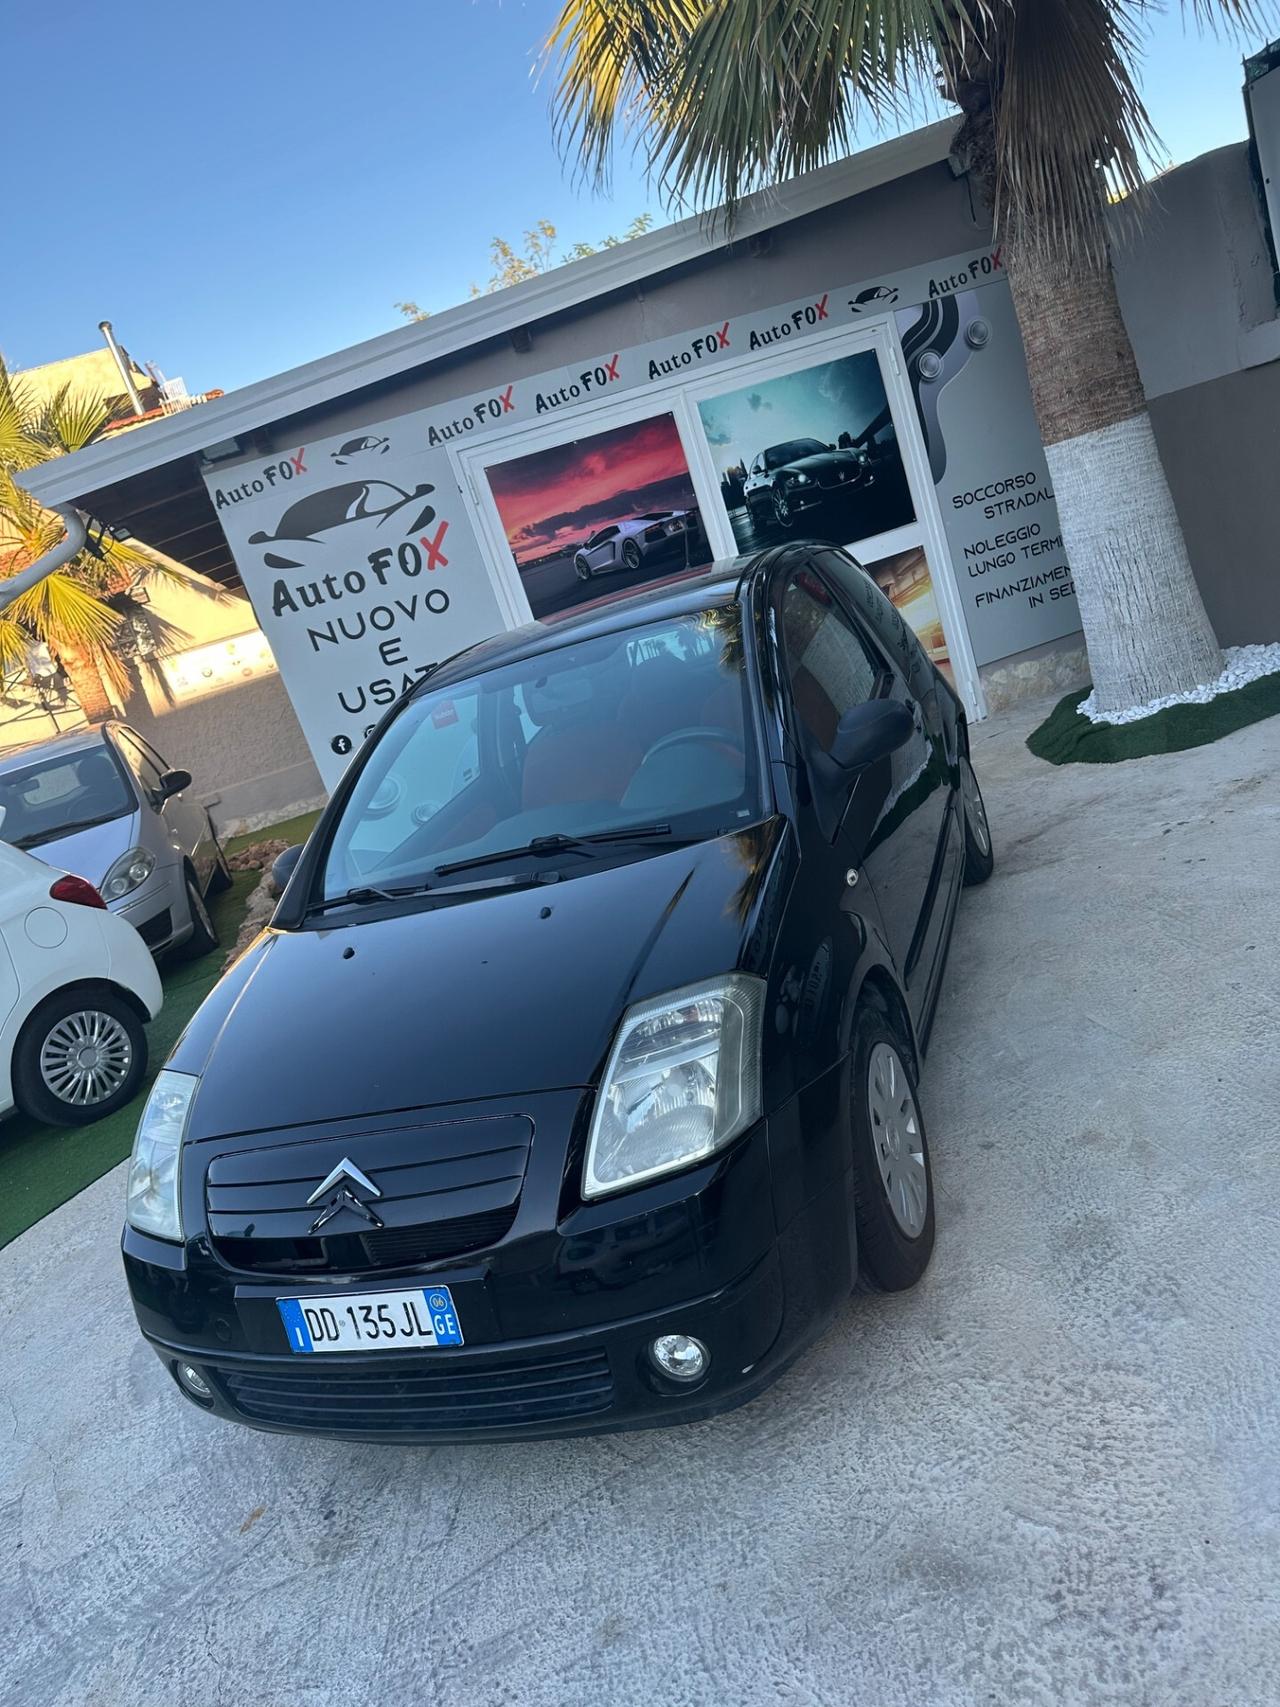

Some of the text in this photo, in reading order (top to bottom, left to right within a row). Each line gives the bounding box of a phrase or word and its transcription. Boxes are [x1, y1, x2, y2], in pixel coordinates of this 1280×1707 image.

[928, 244, 1003, 298] Auto FOX
[750, 293, 828, 350] Auto FOX
[649, 322, 730, 380] Auto FOX
[536, 354, 620, 414] Auto FOX
[428, 385, 515, 446] Auto FOX
[215, 448, 308, 510] Auto FOX
[952, 471, 1036, 509] SOCCORSO
[984, 487, 1055, 519] STRADAL
[964, 522, 1041, 560] NOLEGGIO
[272, 520, 449, 617] Auto FOX
[967, 552, 1016, 578] LUNGO
[307, 588, 450, 652] NUOVO
[1028, 593, 1044, 609] IN
[379, 637, 408, 666] E
[304, 1308, 340, 1341] DD
[433, 1313, 456, 1335] GE
